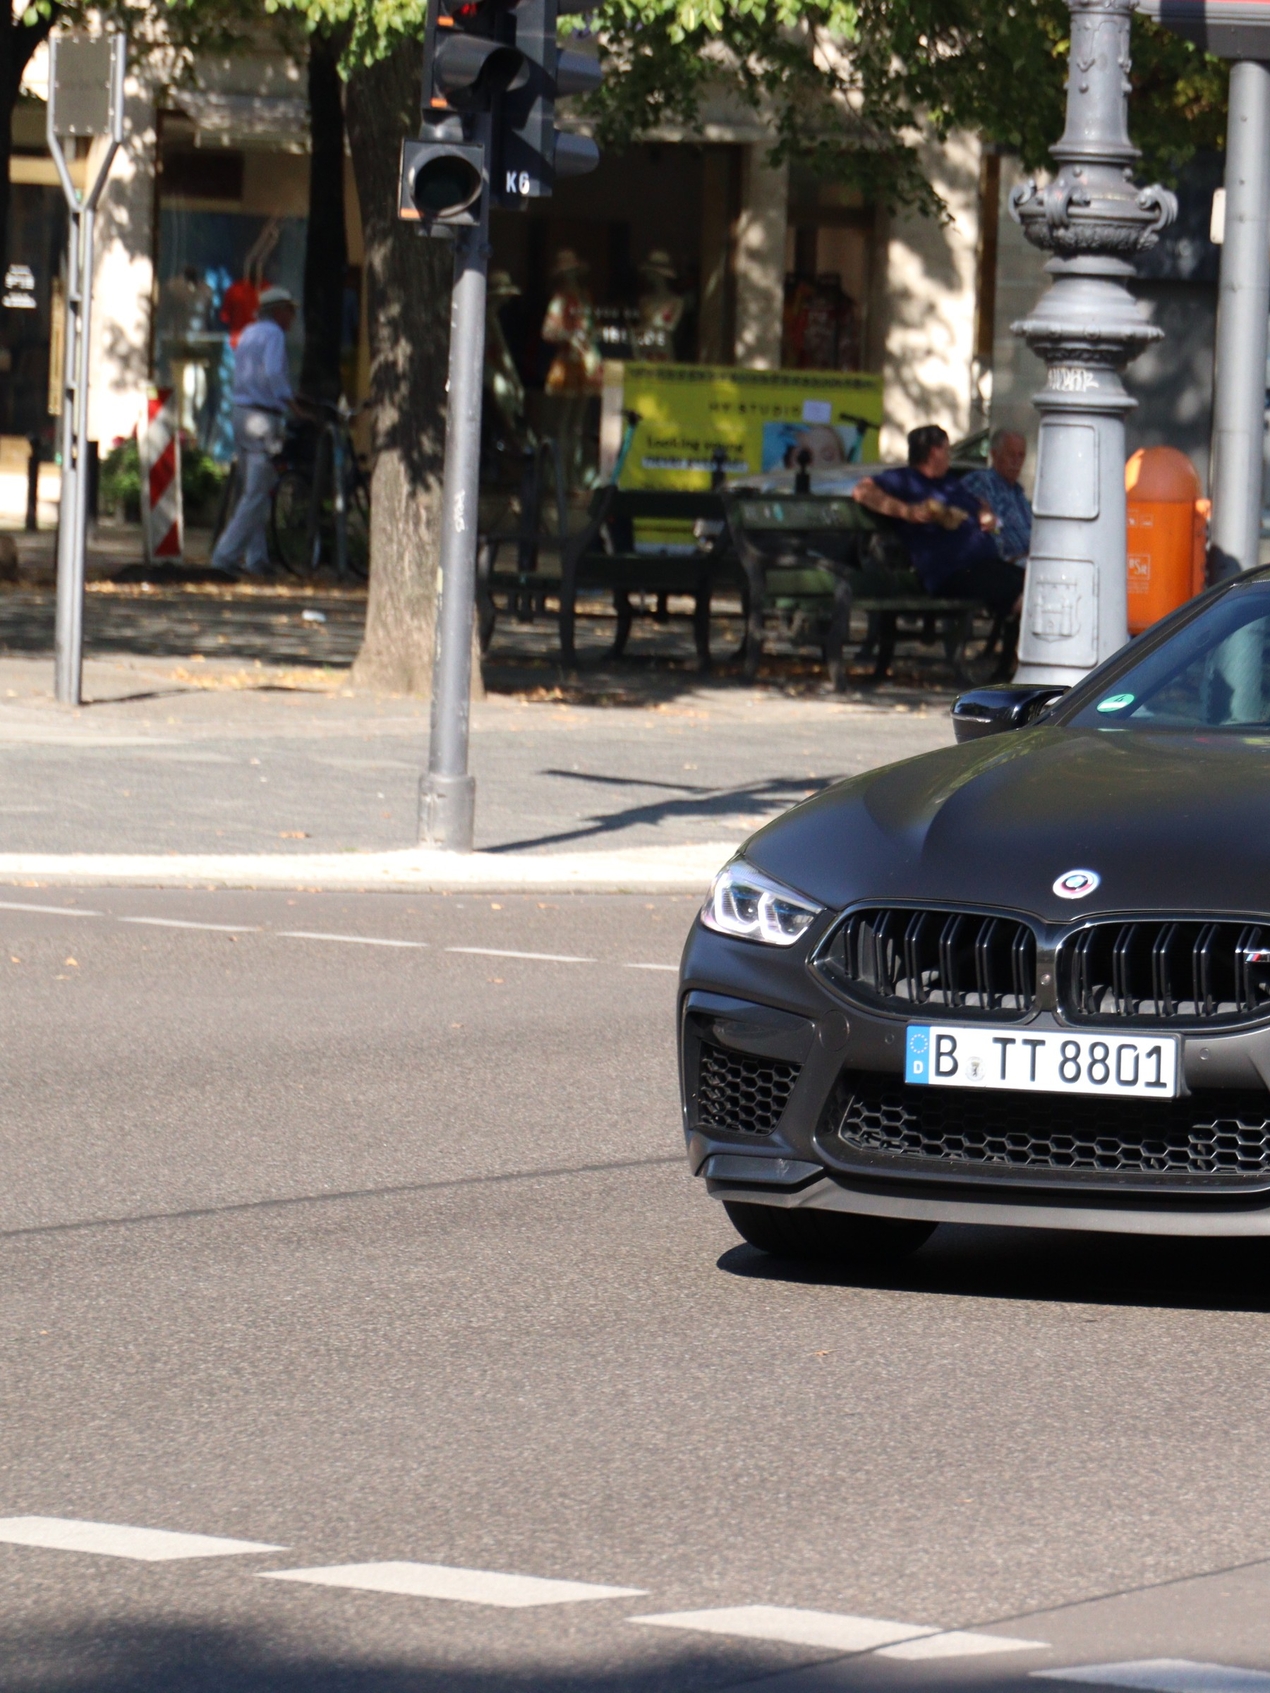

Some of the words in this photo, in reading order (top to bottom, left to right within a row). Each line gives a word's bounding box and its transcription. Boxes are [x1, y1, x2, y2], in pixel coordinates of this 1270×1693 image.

[506, 171, 529, 195] K6
[913, 1060, 924, 1075] D
[934, 1034, 959, 1078] B
[992, 1037, 1046, 1082] TT
[1058, 1040, 1168, 1089] 8801
